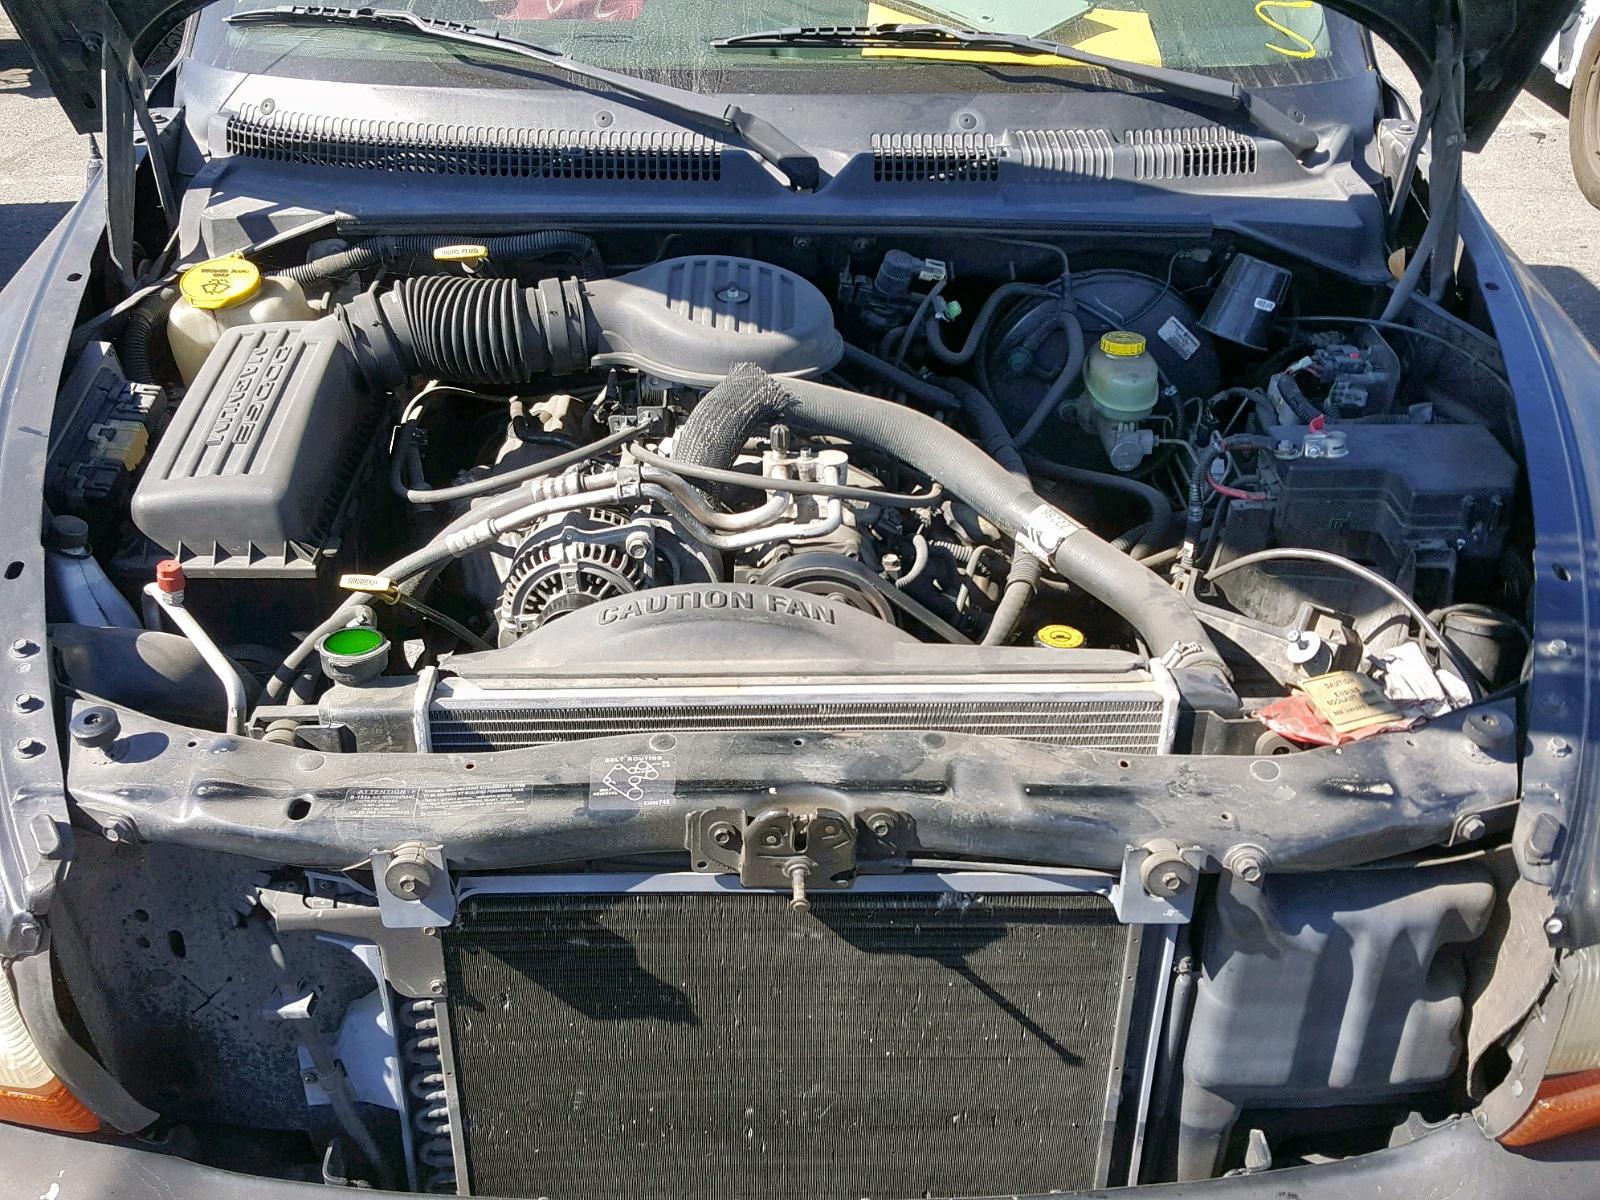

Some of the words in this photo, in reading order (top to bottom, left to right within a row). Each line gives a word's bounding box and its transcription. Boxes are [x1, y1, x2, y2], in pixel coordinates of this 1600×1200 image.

[206, 347, 269, 446] MAGNUM
[231, 345, 293, 445] DODGE
[597, 590, 754, 626] CAUTION
[767, 594, 836, 626] FAN
